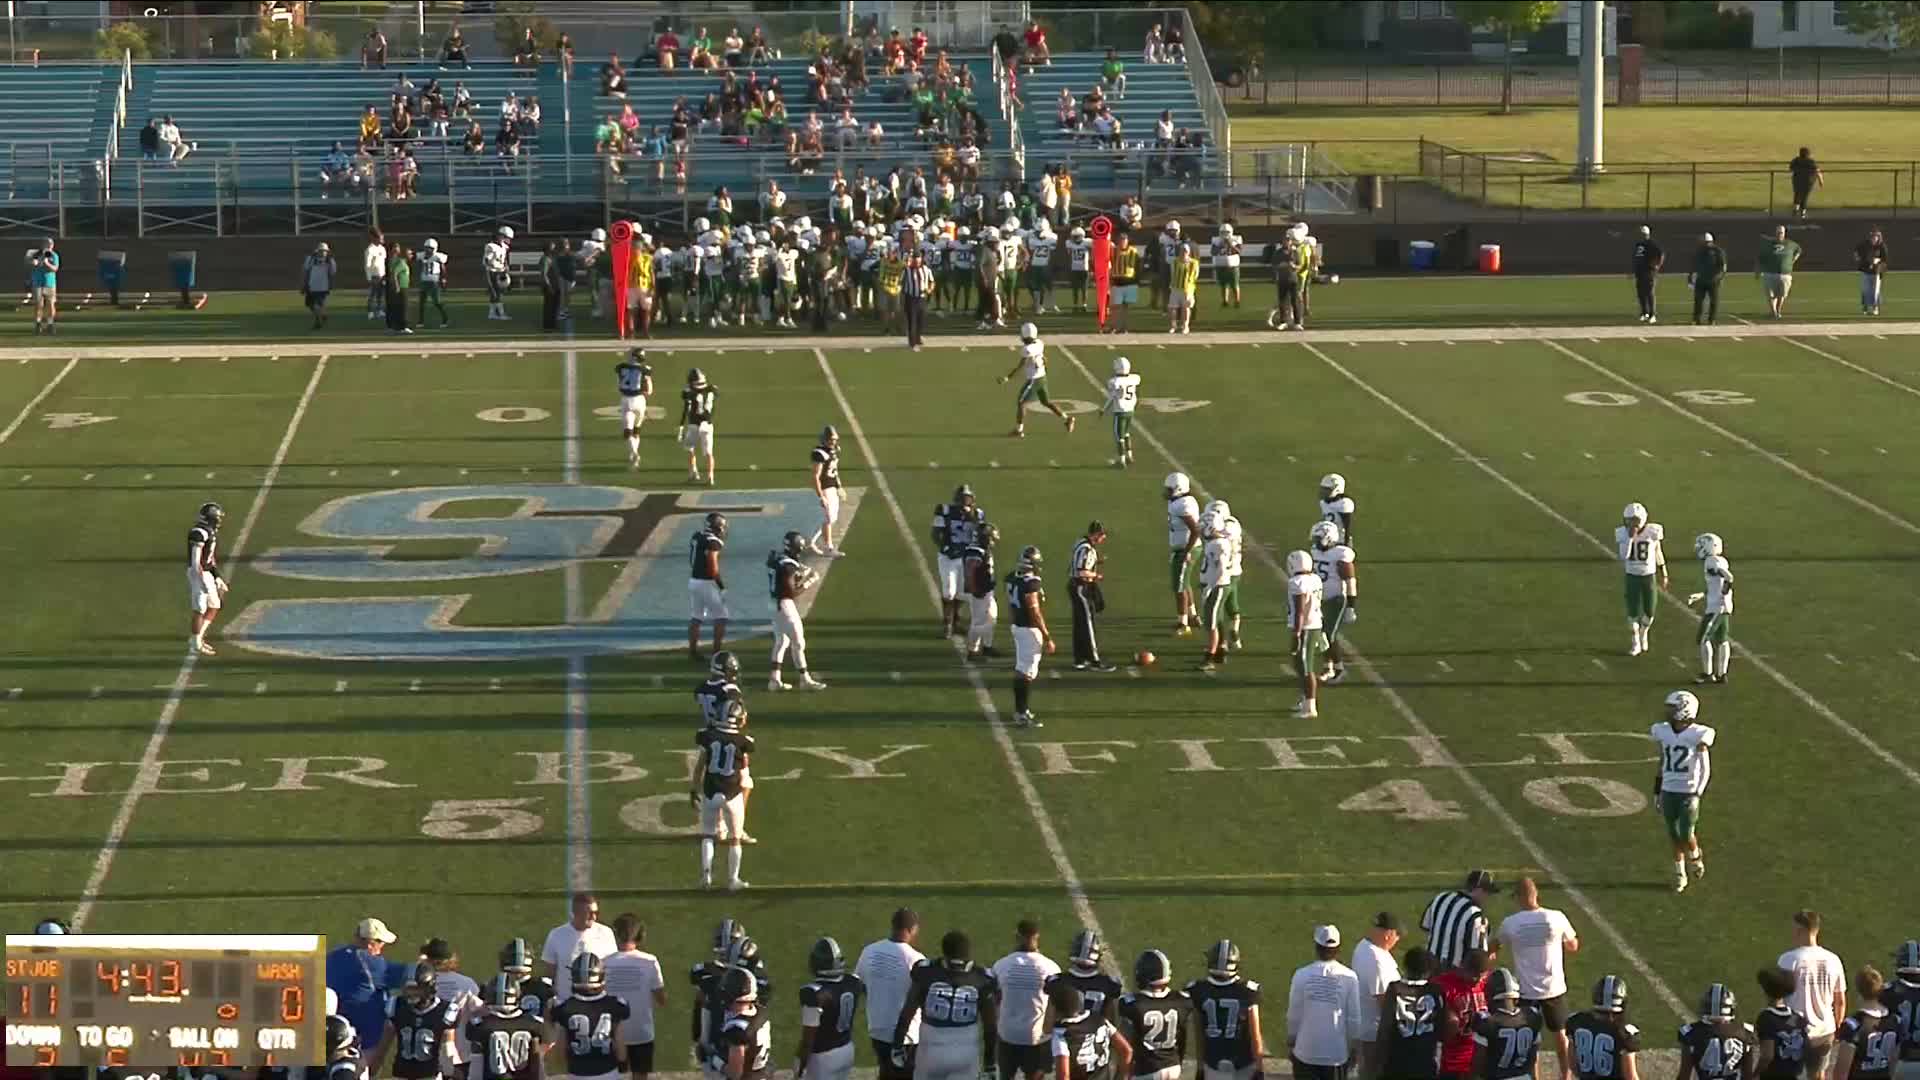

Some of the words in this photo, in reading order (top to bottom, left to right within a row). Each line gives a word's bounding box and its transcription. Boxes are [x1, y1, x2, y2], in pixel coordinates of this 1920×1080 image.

[709, 740, 737, 776] 11
[1664, 743, 1690, 773] 12
[567, 1012, 613, 1056] 34
[1143, 1008, 1179, 1051] 21
[1202, 998, 1240, 1039] 17
[1395, 993, 1440, 1037] 52
